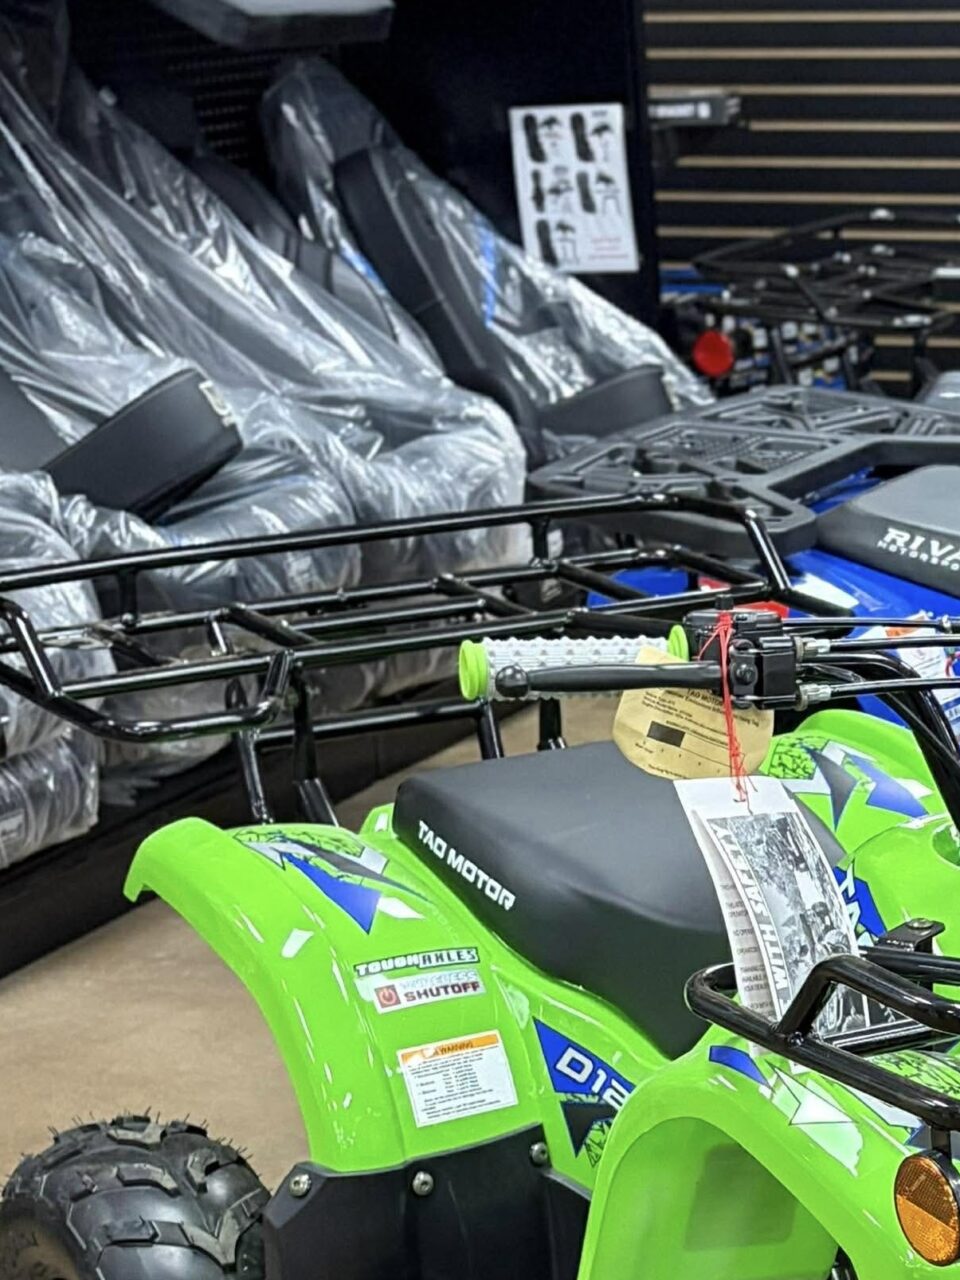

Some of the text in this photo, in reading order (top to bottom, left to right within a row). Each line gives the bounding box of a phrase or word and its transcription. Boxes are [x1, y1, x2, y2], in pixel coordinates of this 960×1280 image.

[418, 820, 517, 912] TAO MOTOR
[709, 822, 769, 919] SAFETY
[403, 980, 480, 1003] SHUTOFF
[758, 922, 789, 990] WITH
